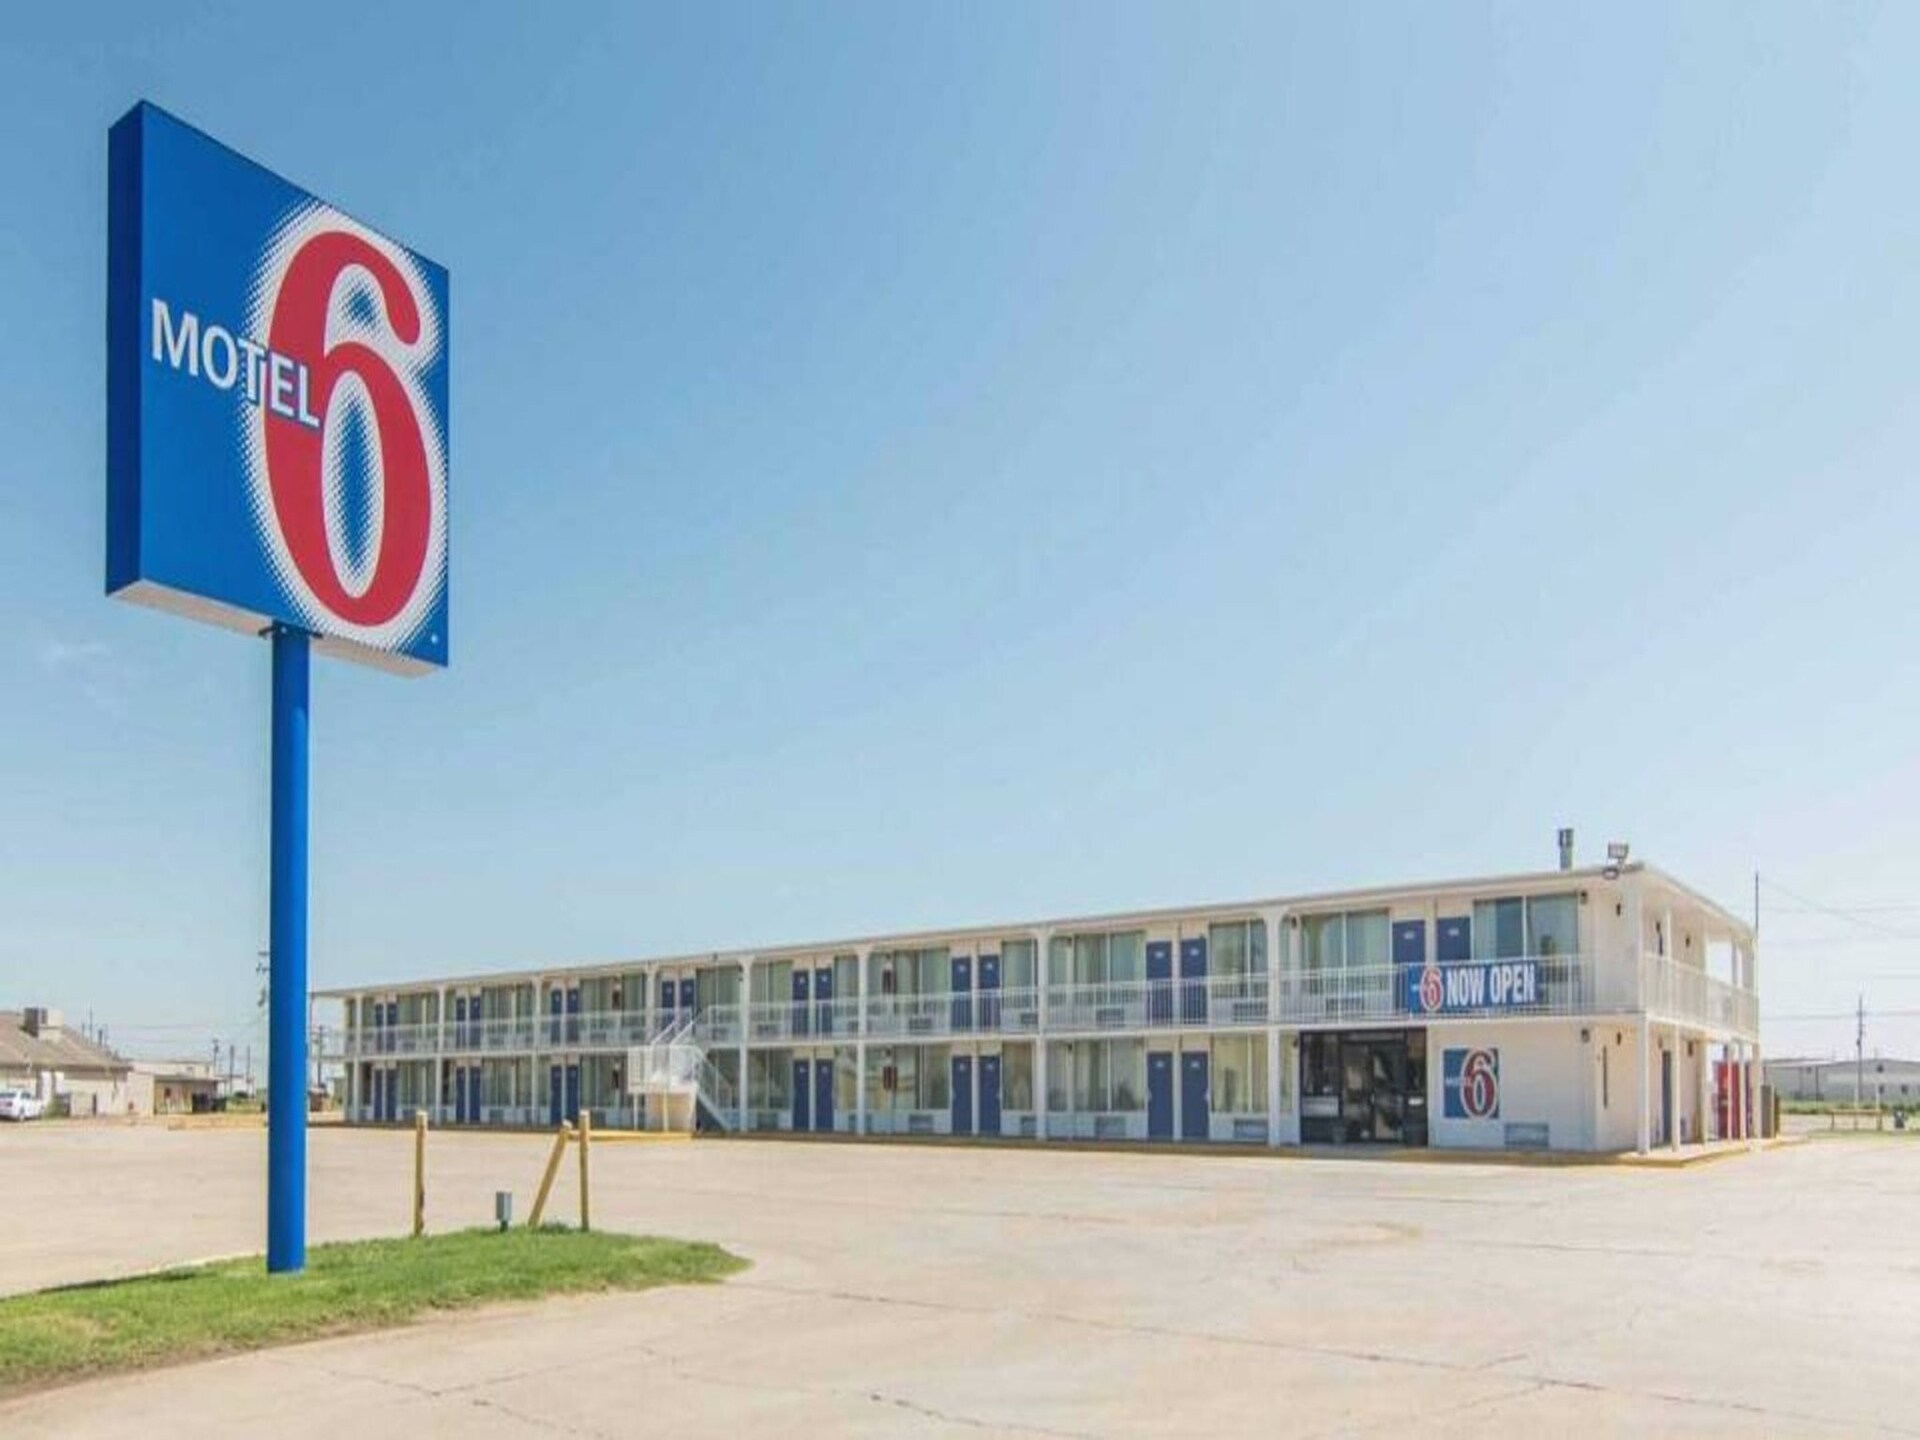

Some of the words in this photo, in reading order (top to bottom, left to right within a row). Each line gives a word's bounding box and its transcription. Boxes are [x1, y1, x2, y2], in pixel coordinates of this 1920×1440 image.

[152, 298, 320, 427] MOTEL
[263, 231, 431, 627] 6
[1420, 967, 1443, 1011] 6
[1446, 967, 1486, 1006] NOW
[1490, 964, 1536, 1004] OPEN
[1463, 1050, 1495, 1116] 6
